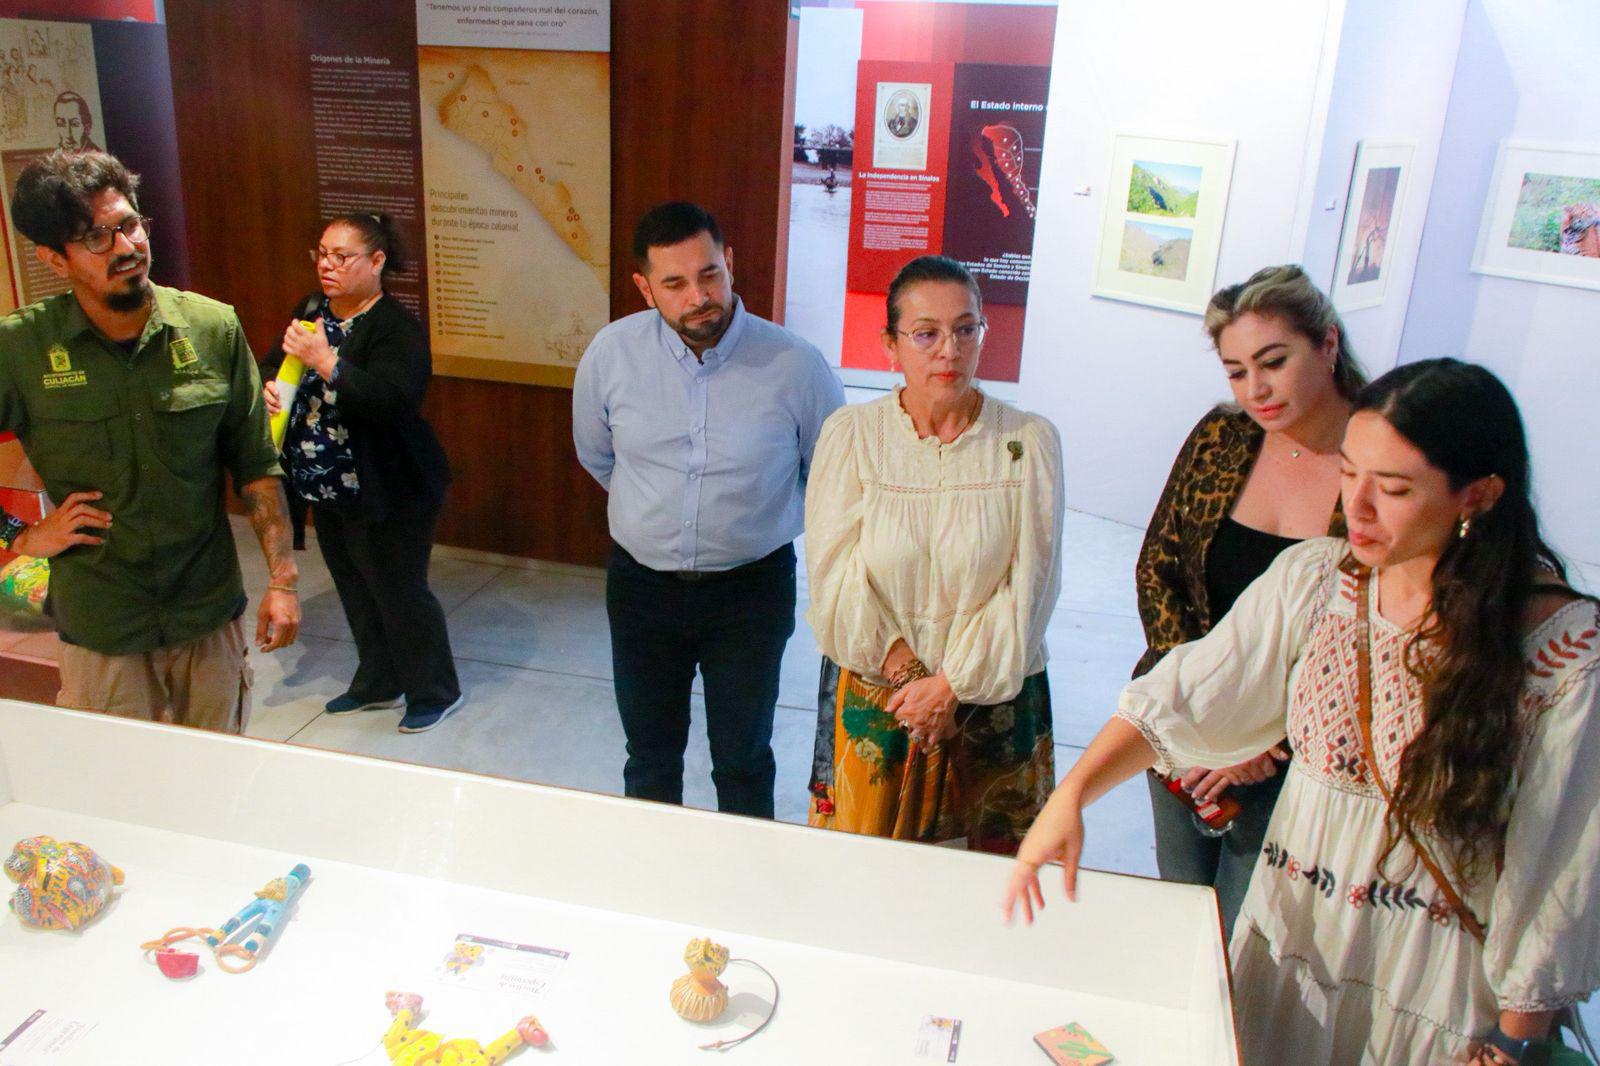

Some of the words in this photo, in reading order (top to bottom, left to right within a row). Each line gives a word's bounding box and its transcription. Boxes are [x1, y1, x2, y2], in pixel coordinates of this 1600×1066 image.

[493, 6, 538, 14] compañeros
[540, 6, 553, 14] mal
[457, 17, 500, 25] enfermedad
[501, 19, 515, 27] que
[355, 56, 363, 64] la
[970, 100, 979, 109] El
[981, 100, 1011, 110] Estado
[1012, 101, 1044, 111] interno
[430, 188, 469, 201] Principales
[489, 207, 518, 217] mineros
[431, 216, 459, 227] durante
[460, 218, 467, 228] la
